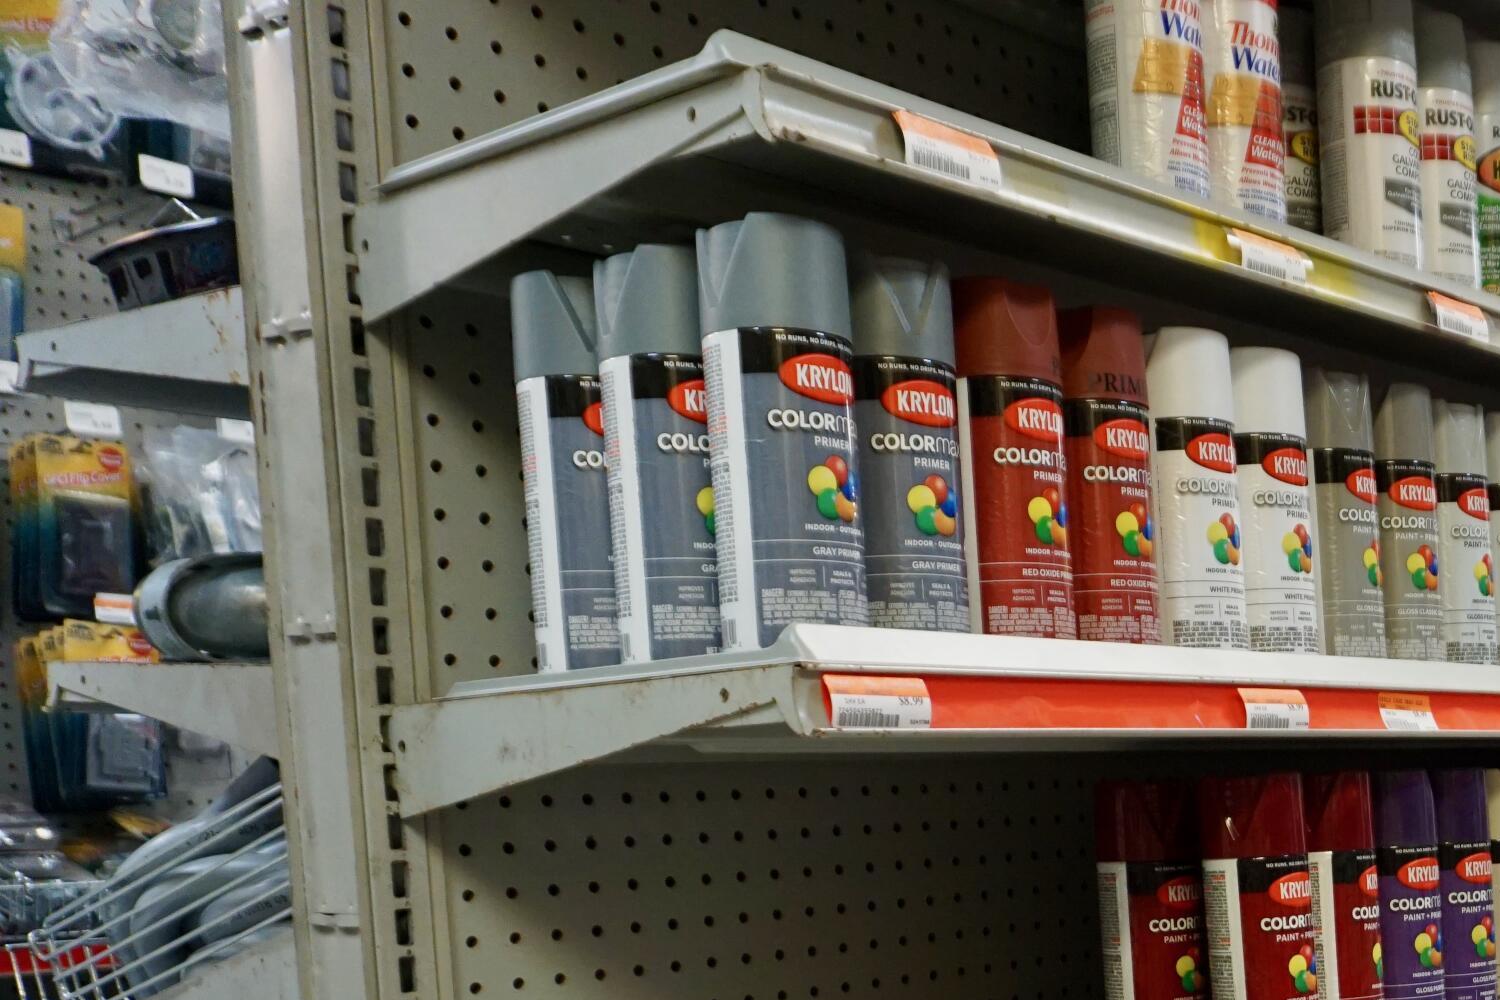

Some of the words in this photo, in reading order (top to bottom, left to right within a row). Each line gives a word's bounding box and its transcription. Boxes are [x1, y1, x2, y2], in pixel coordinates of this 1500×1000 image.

[1228, 21, 1280, 50] Thom
[1370, 79, 1417, 102] RUST-O
[796, 362, 853, 397] KRYLON
[1091, 371, 1146, 397] PRIM
[897, 389, 954, 419] KRYLON
[767, 408, 858, 438] COLORma
[814, 436, 852, 450] PRIMER
[1198, 441, 1236, 465] KRYLO
[914, 456, 950, 470] PRIMER
[1034, 470, 1062, 483] PRIMER
[805, 523, 833, 532] INDOOR
[904, 539, 933, 548] INDOOR
[813, 546, 836, 556] GRAY
[912, 561, 935, 570] GRAY
[937, 562, 961, 572] PRIMER
[1022, 568, 1038, 577] RED
[1039, 568, 1060, 578] OXIDE
[1110, 578, 1126, 587] RED
[1127, 579, 1147, 588] OXIDE
[1210, 585, 1230, 594] WHITE
[1284, 592, 1305, 600] WHITE
[1465, 861, 1492, 879] KRYLO
[1461, 905, 1479, 915] PAINT
[1403, 913, 1425, 922] PAINT
[1163, 935, 1188, 944] PAINT
[1276, 933, 1299, 943] PAINT
